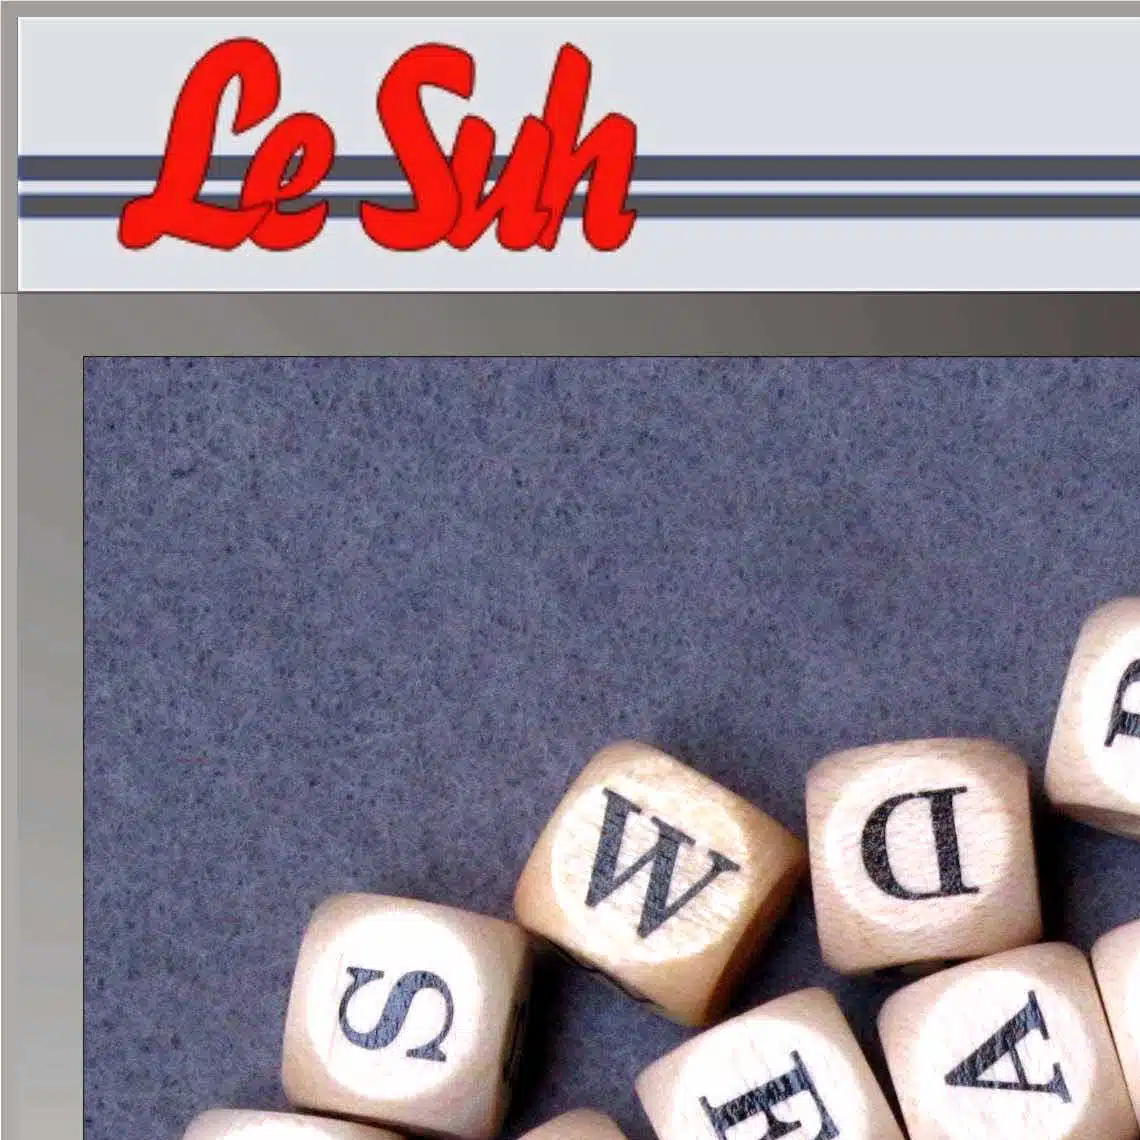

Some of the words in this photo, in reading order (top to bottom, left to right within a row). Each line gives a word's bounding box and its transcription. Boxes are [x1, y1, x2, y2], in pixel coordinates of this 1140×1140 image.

[582, 787, 740, 941] W
[861, 787, 979, 900] D
[339, 967, 453, 1061] S
[945, 991, 1070, 1101] A
